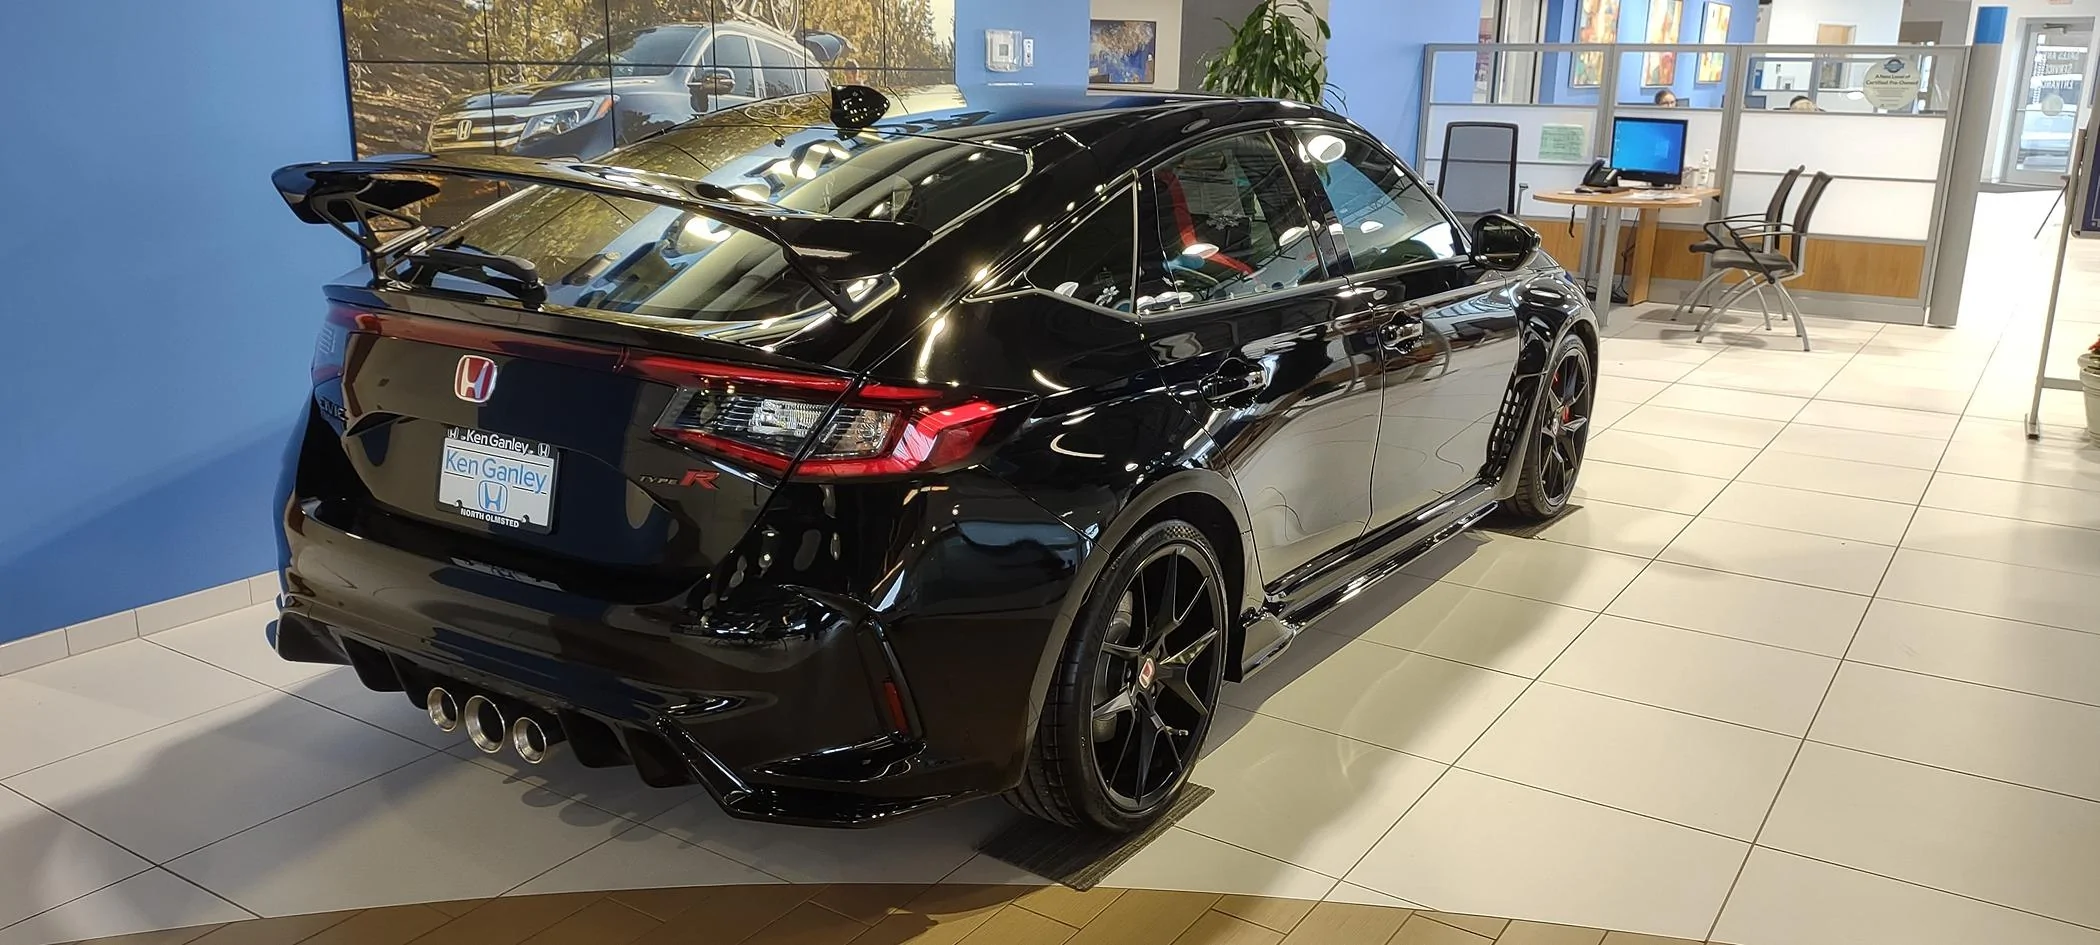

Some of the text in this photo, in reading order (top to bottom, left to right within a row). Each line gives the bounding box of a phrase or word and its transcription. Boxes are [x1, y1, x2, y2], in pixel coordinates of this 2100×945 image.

[466, 429, 529, 455] Ken Ganley
[445, 449, 547, 494] Ken Ganley
[640, 469, 720, 490] TYPE R
[460, 507, 520, 528] NORTH OLMSTED
